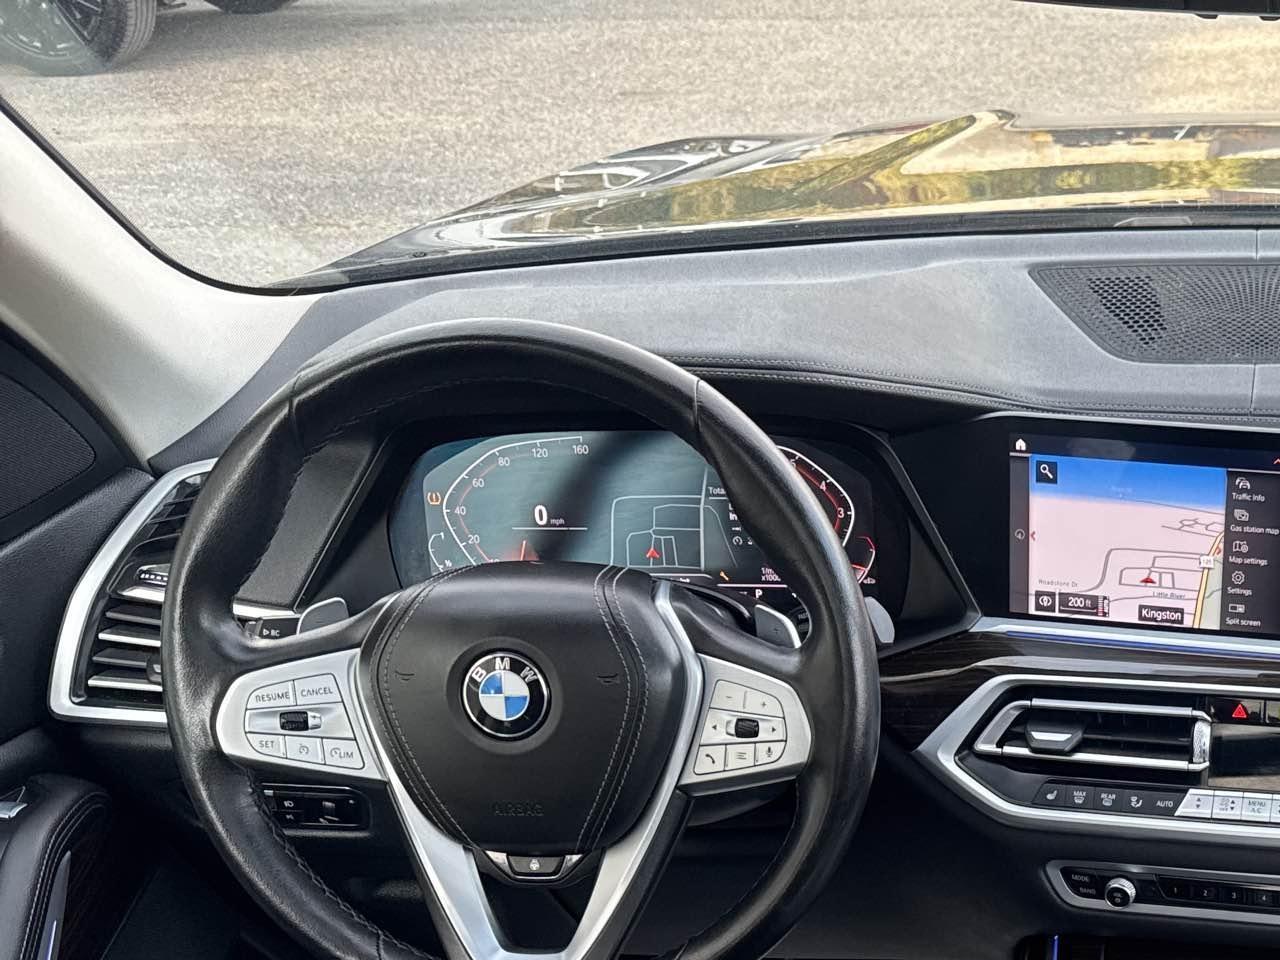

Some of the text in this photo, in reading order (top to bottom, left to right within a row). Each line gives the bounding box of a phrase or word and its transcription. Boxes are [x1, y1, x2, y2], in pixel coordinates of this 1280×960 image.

[531, 448, 549, 458] 120
[572, 444, 589, 455] 160
[498, 457, 510, 467] 80
[472, 479, 485, 488] 60
[820, 480, 826, 491] 4
[708, 486, 726, 495] Tota
[1232, 492, 1265, 502] Traffic info
[454, 506, 466, 516] 40
[534, 505, 565, 526] 0 mph
[838, 507, 845, 518] 3
[1230, 524, 1242, 532] Gas
[1243, 525, 1264, 533] station
[468, 534, 480, 544] 20
[1229, 556, 1268, 566] Map settings
[755, 589, 763, 598] P
[1227, 587, 1252, 597] Settings
[1068, 596, 1084, 607] 200
[1141, 607, 1182, 621] Kingston
[1225, 617, 1261, 627] Split screen
[471, 657, 538, 683] BMW
[255, 687, 334, 702] RESUME CANCEL
[258, 740, 274, 749] SET
[338, 748, 354, 759] LIM
[1101, 793, 1116, 801] REAR
[1156, 800, 1174, 808] AUTO
